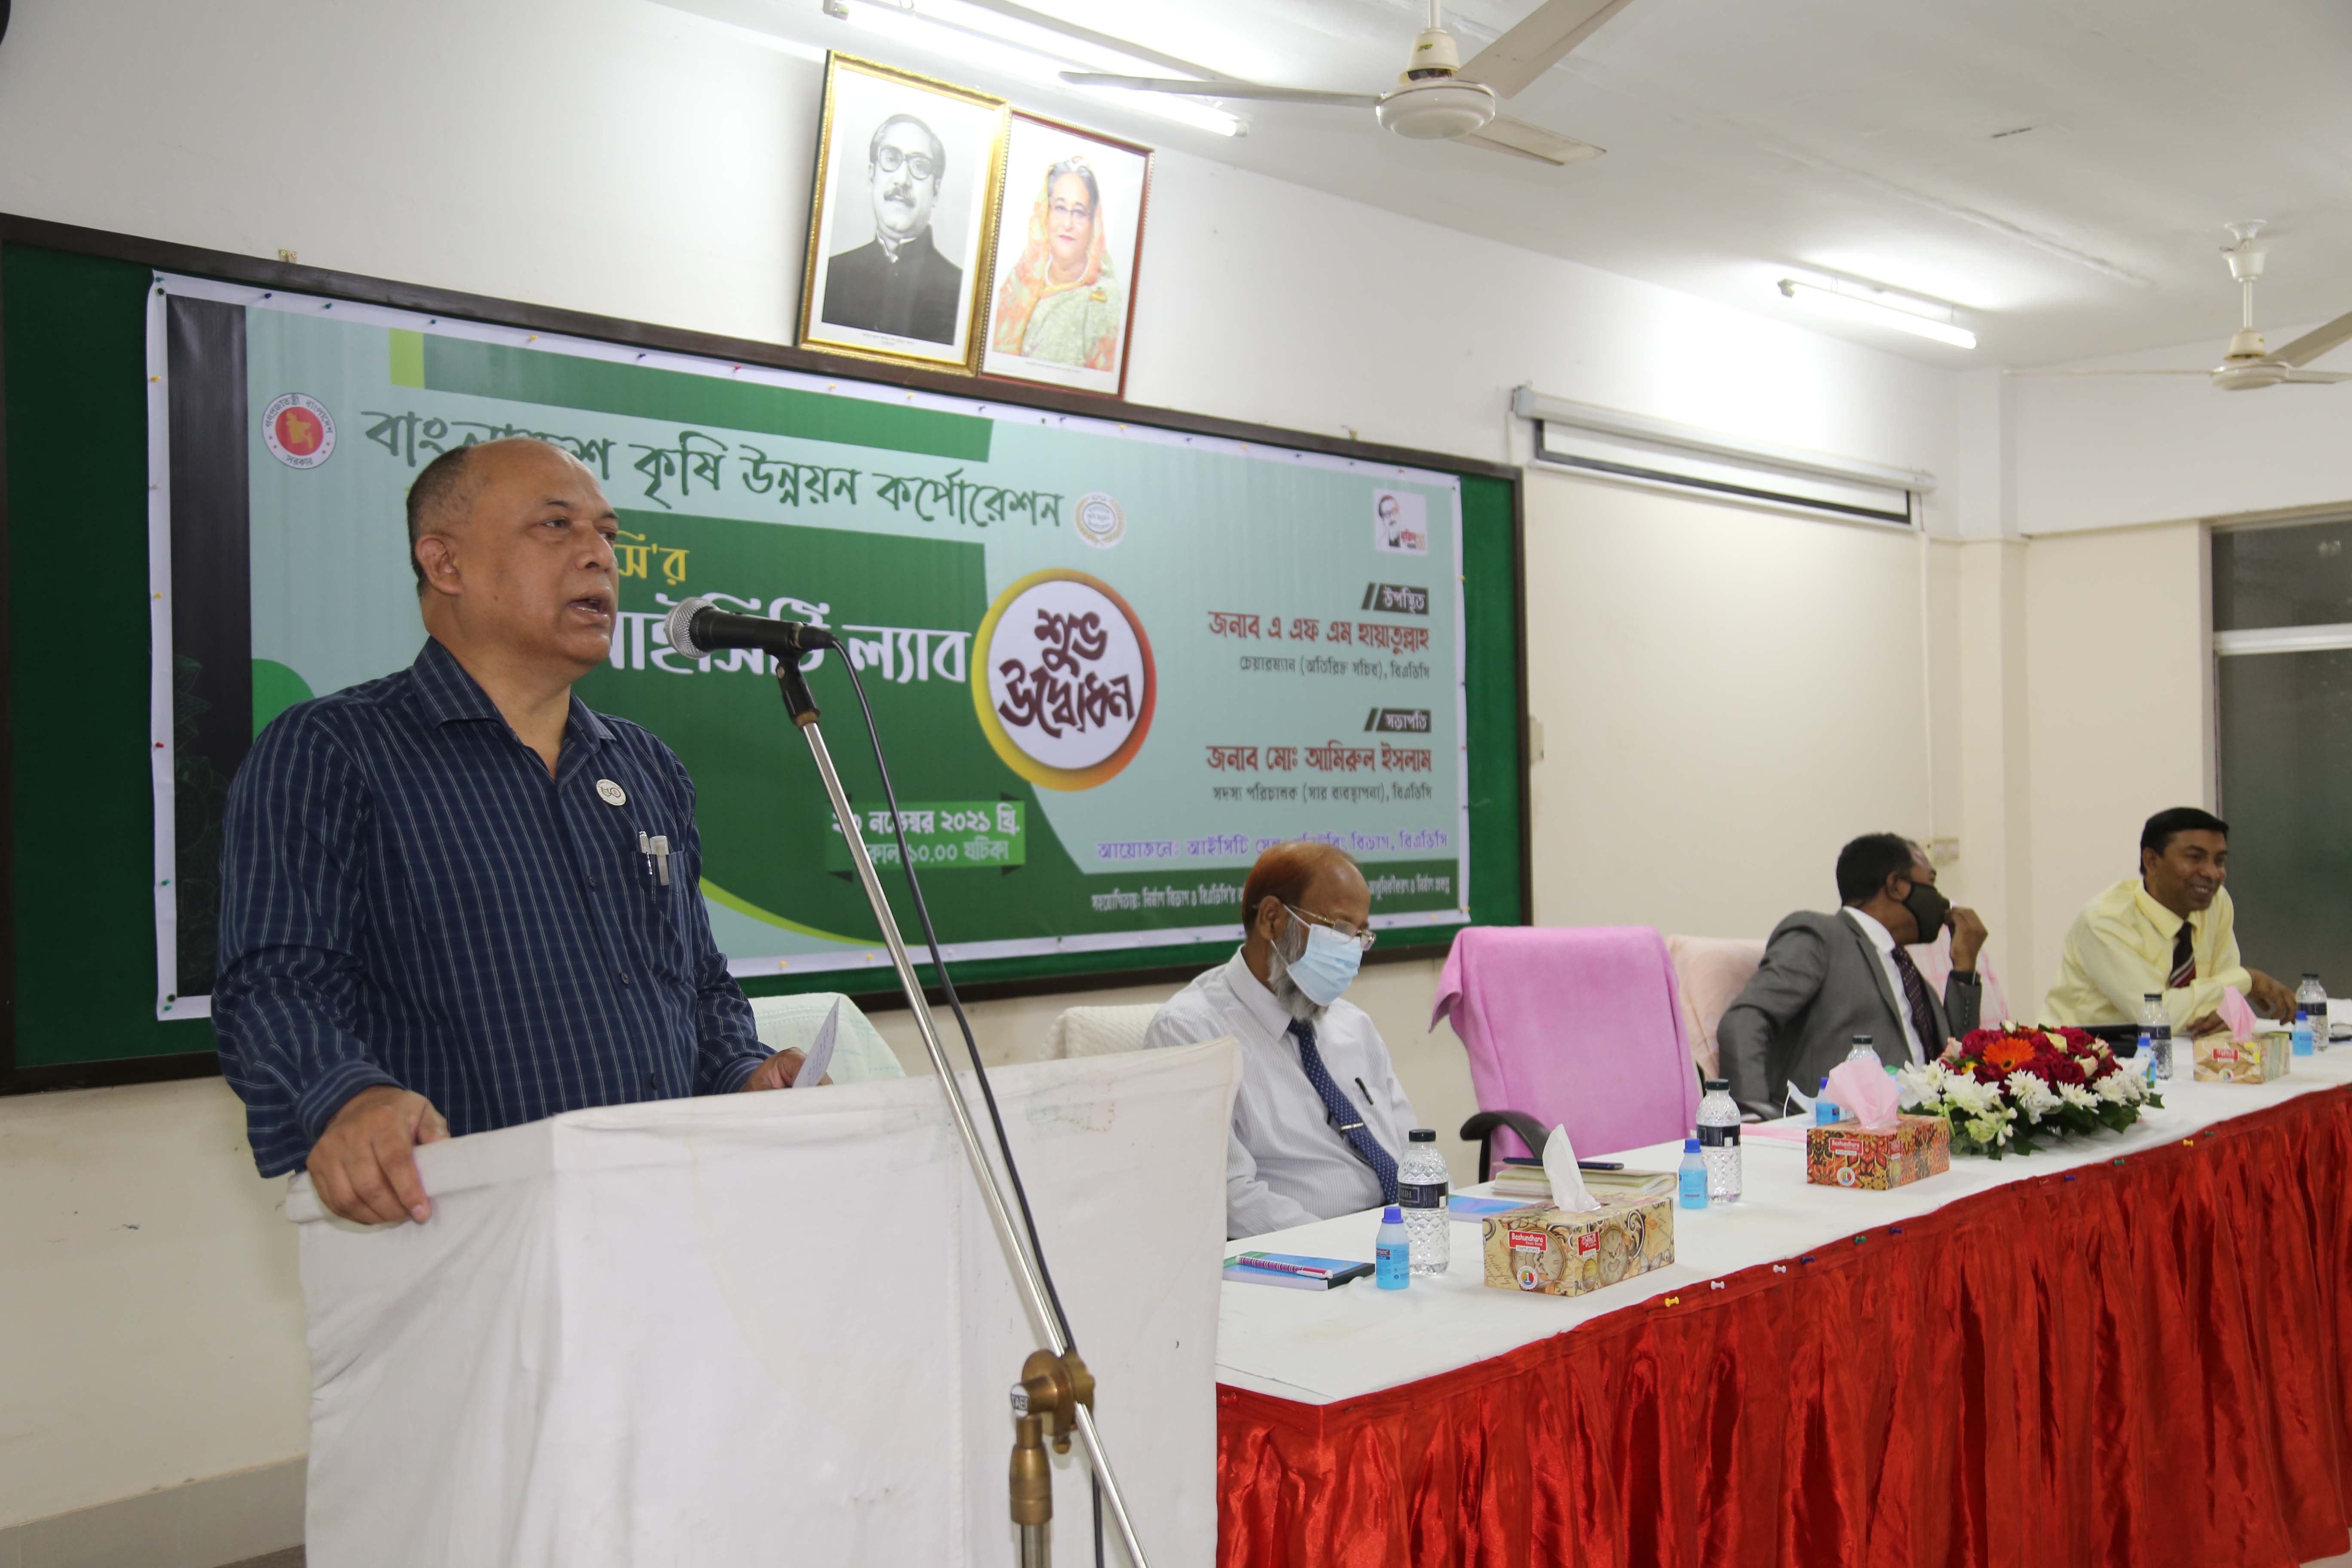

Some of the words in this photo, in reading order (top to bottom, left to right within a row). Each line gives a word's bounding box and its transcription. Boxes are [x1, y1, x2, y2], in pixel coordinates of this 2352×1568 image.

[286, 454, 313, 466] সরকার
[628, 431, 729, 509] কৃষি
[738, 444, 862, 507] উন্নয়ন
[872, 468, 1065, 527] কর্পোরেশন
[1383, 586, 1425, 613] উপস্থিত
[1207, 610, 1261, 640] জনাব
[1268, 616, 1282, 639] এ
[1289, 618, 1320, 642] এফ
[1326, 621, 1352, 645] এম
[841, 624, 972, 683] ল্যাব
[1034, 608, 1108, 678] শুভ
[1240, 655, 1296, 673] চেয়ারম্যান
[1390, 661, 1430, 680] বিএডিসি
[998, 658, 1136, 739] উদ্বোধন
[1385, 709, 1428, 730] সভাপতি
[1206, 745, 1259, 772] জনাব
[1266, 746, 1298, 772] মোঃ
[1304, 739, 1376, 772] আমিরুল
[1380, 741, 1432, 772] ইসলাম
[1213, 786, 1243, 802] সদস্য
[1247, 782, 1298, 802] পরিচালক
[1303, 782, 1328, 804] (সার
[1392, 781, 1432, 801] বিএডিসি
[940, 810, 991, 833] ২০২১
[963, 835, 1010, 861] ঘটিকা
[1186, 833, 1249, 857] আইসিটি
[1351, 830, 1396, 852] বিভাগ,
[1399, 828, 1449, 849] বিএডিসি
[1166, 885, 1190, 907] বিভাগ
[1512, 1233, 1544, 1243] Bashundhara
[1525, 1272, 1531, 1283] 1
